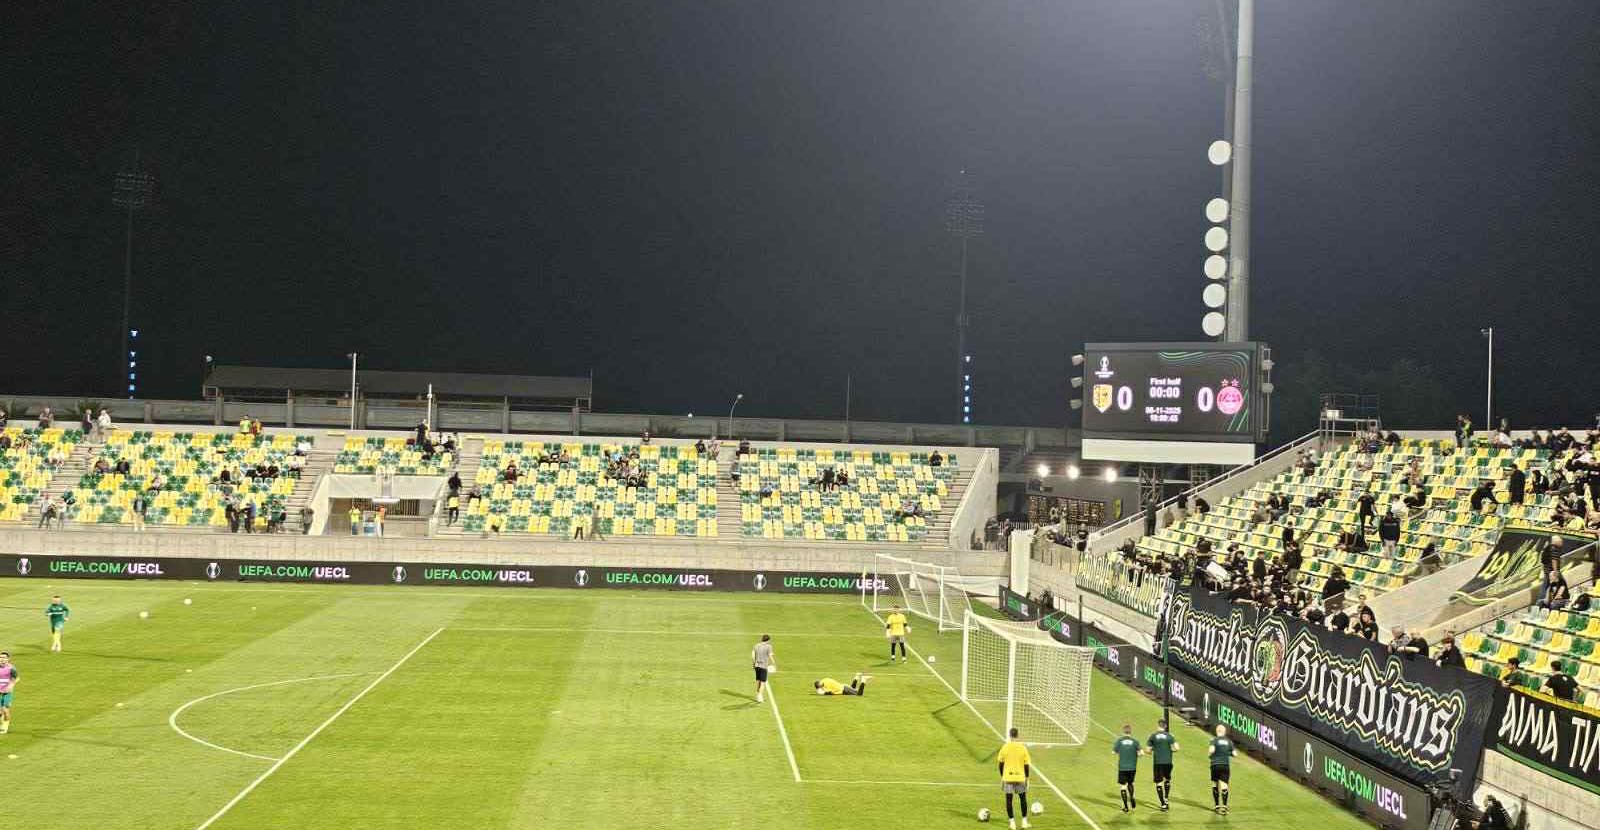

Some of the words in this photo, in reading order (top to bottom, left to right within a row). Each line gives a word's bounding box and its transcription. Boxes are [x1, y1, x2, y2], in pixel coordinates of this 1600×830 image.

[1167, 378, 1181, 386] half
[1117, 386, 1132, 410] 0
[1150, 386, 1180, 398] 00:00
[1198, 387, 1213, 412] 0
[50, 561, 164, 575] UEFA.COM/UECL
[238, 564, 350, 579] UEFA.COM/UECL
[423, 568, 534, 583] UEFA.COM/UECL
[605, 572, 713, 587] UEFA.COM/UECL
[783, 576, 890, 591] UEFA.COM/UECL
[1171, 602, 1251, 673] Larnaka
[1284, 640, 1458, 756] Guardians
[1217, 704, 1278, 751] UEFA.COM/UECL
[1324, 758, 1408, 820] UEFA.COM/UECL
